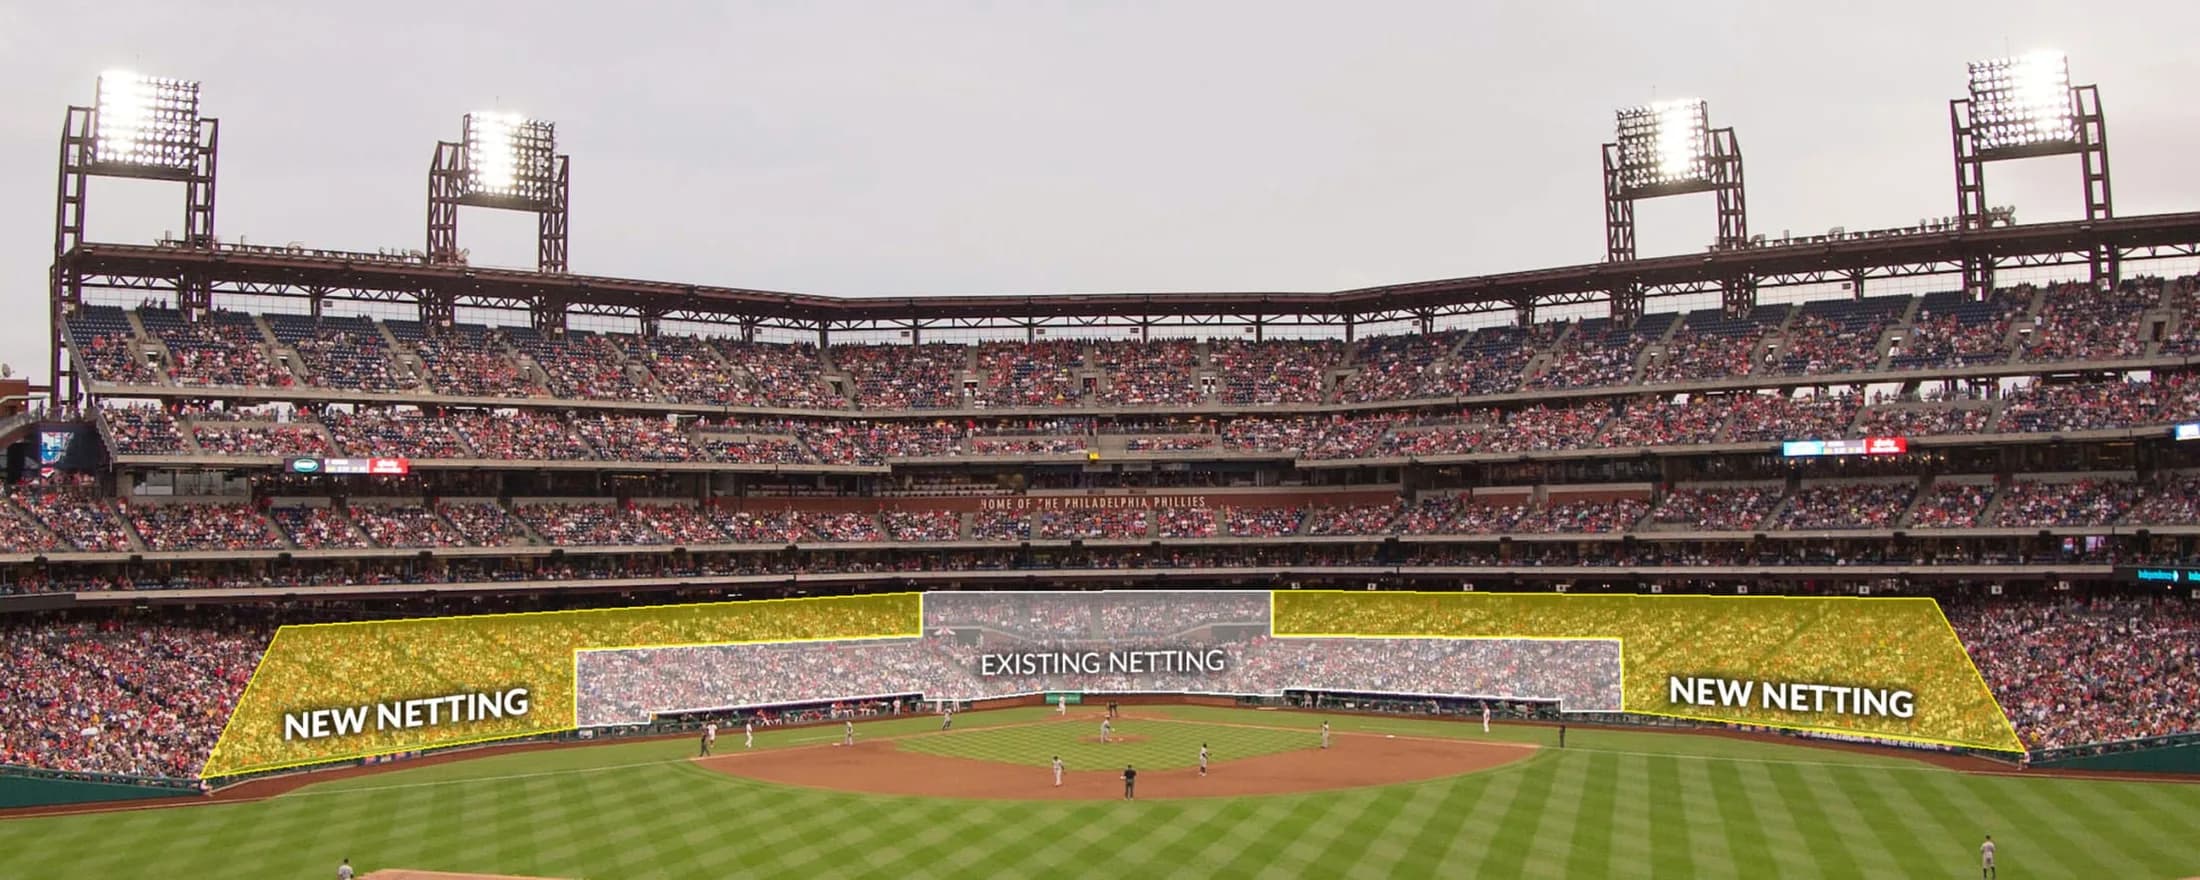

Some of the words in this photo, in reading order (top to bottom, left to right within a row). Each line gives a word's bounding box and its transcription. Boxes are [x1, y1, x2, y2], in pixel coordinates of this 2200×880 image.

[981, 498, 1012, 510] HOME
[1017, 498, 1032, 509] OF
[1065, 496, 1148, 509] PHILADELPHIA
[1154, 496, 1205, 508] PHILLIES
